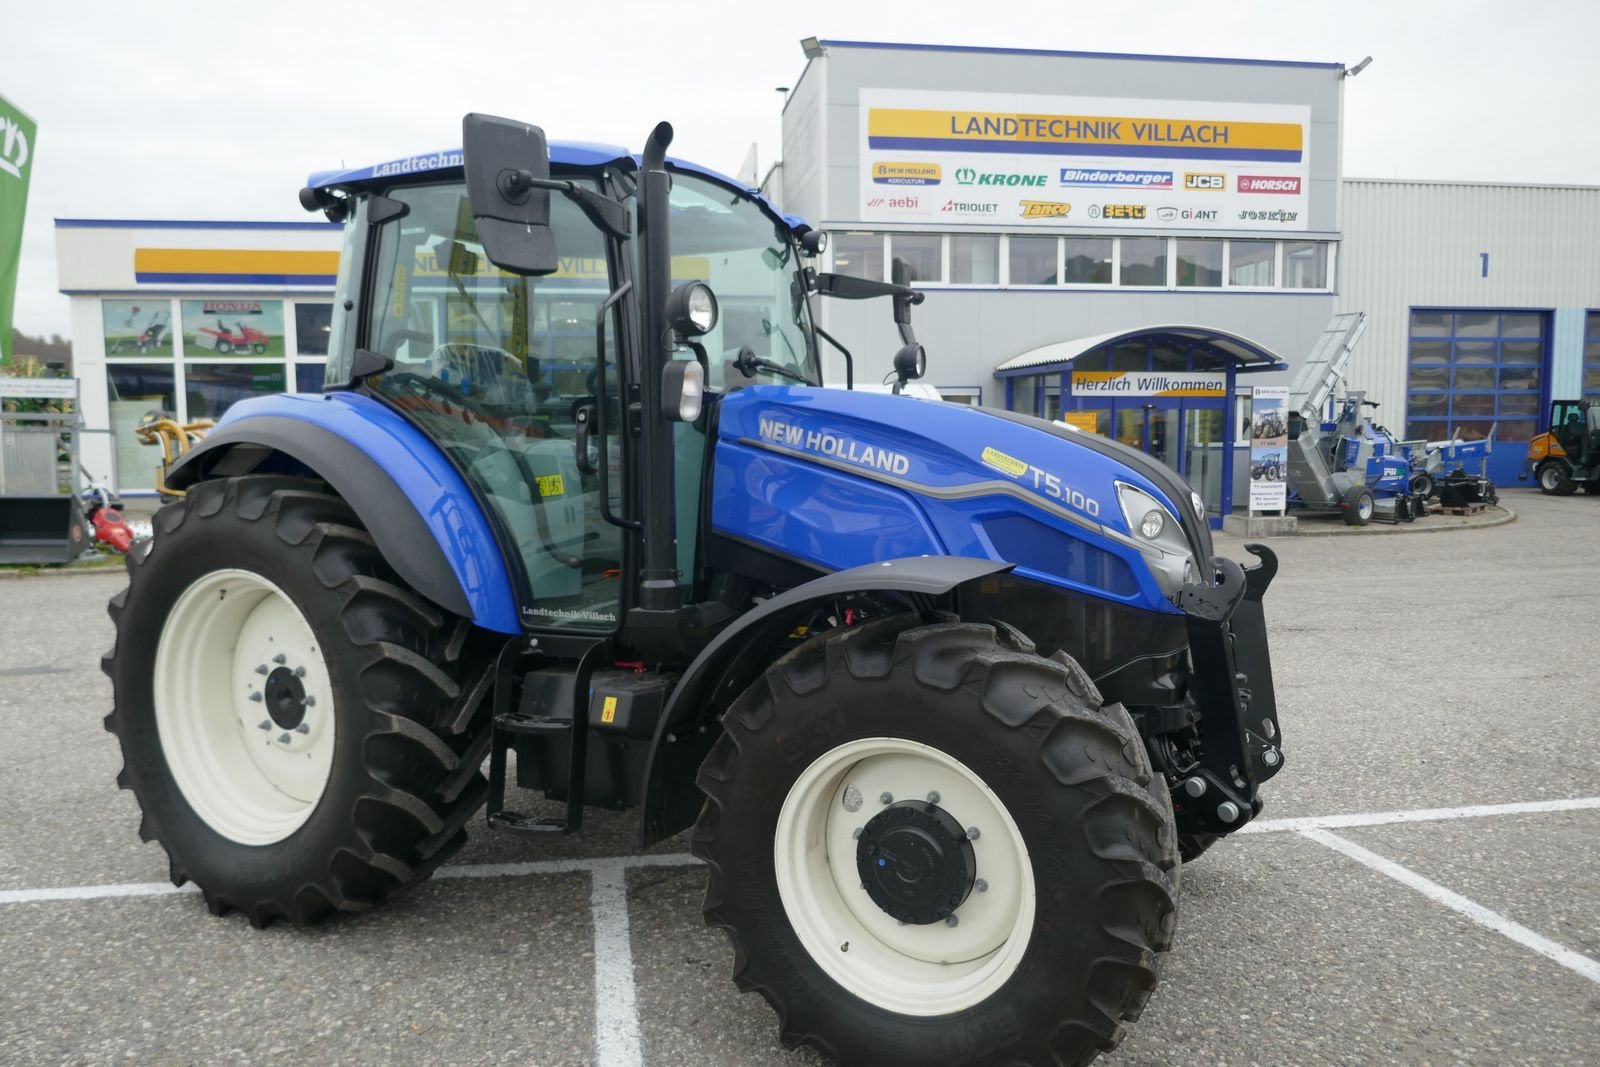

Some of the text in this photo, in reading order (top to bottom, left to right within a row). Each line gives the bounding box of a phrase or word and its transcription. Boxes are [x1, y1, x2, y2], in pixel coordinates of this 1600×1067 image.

[951, 115, 1229, 144] LANDTECHNIK VILLACH
[888, 167, 905, 175] NEW
[1064, 170, 1170, 185] Binderberger
[978, 173, 1048, 187] KRONE
[1187, 176, 1223, 188] JCB
[1250, 180, 1297, 190] HORSCH
[889, 196, 918, 208] aebi
[1019, 200, 1071, 218] Tanco
[1479, 252, 1489, 278] 1
[203, 302, 262, 311] HONDA
[1075, 378, 1222, 391] Herzlich Willkommen
[758, 418, 909, 476] NEW HOLLAND
[1029, 465, 1099, 517] T5.100
